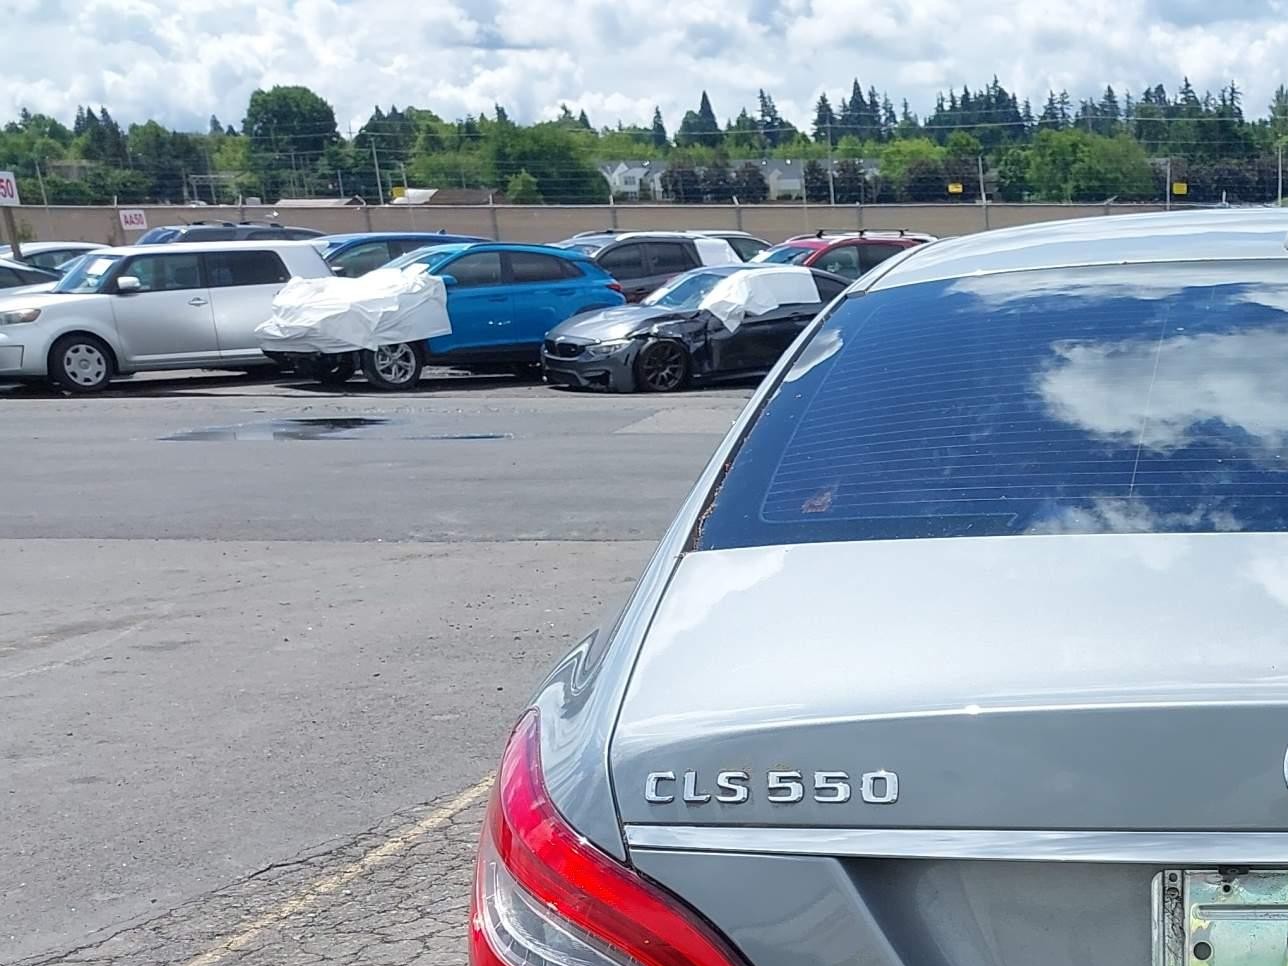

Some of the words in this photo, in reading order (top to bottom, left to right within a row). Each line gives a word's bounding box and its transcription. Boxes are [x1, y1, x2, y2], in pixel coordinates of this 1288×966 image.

[123, 213, 145, 226] AA50
[644, 769, 749, 804] CLS
[766, 769, 900, 804] 550
